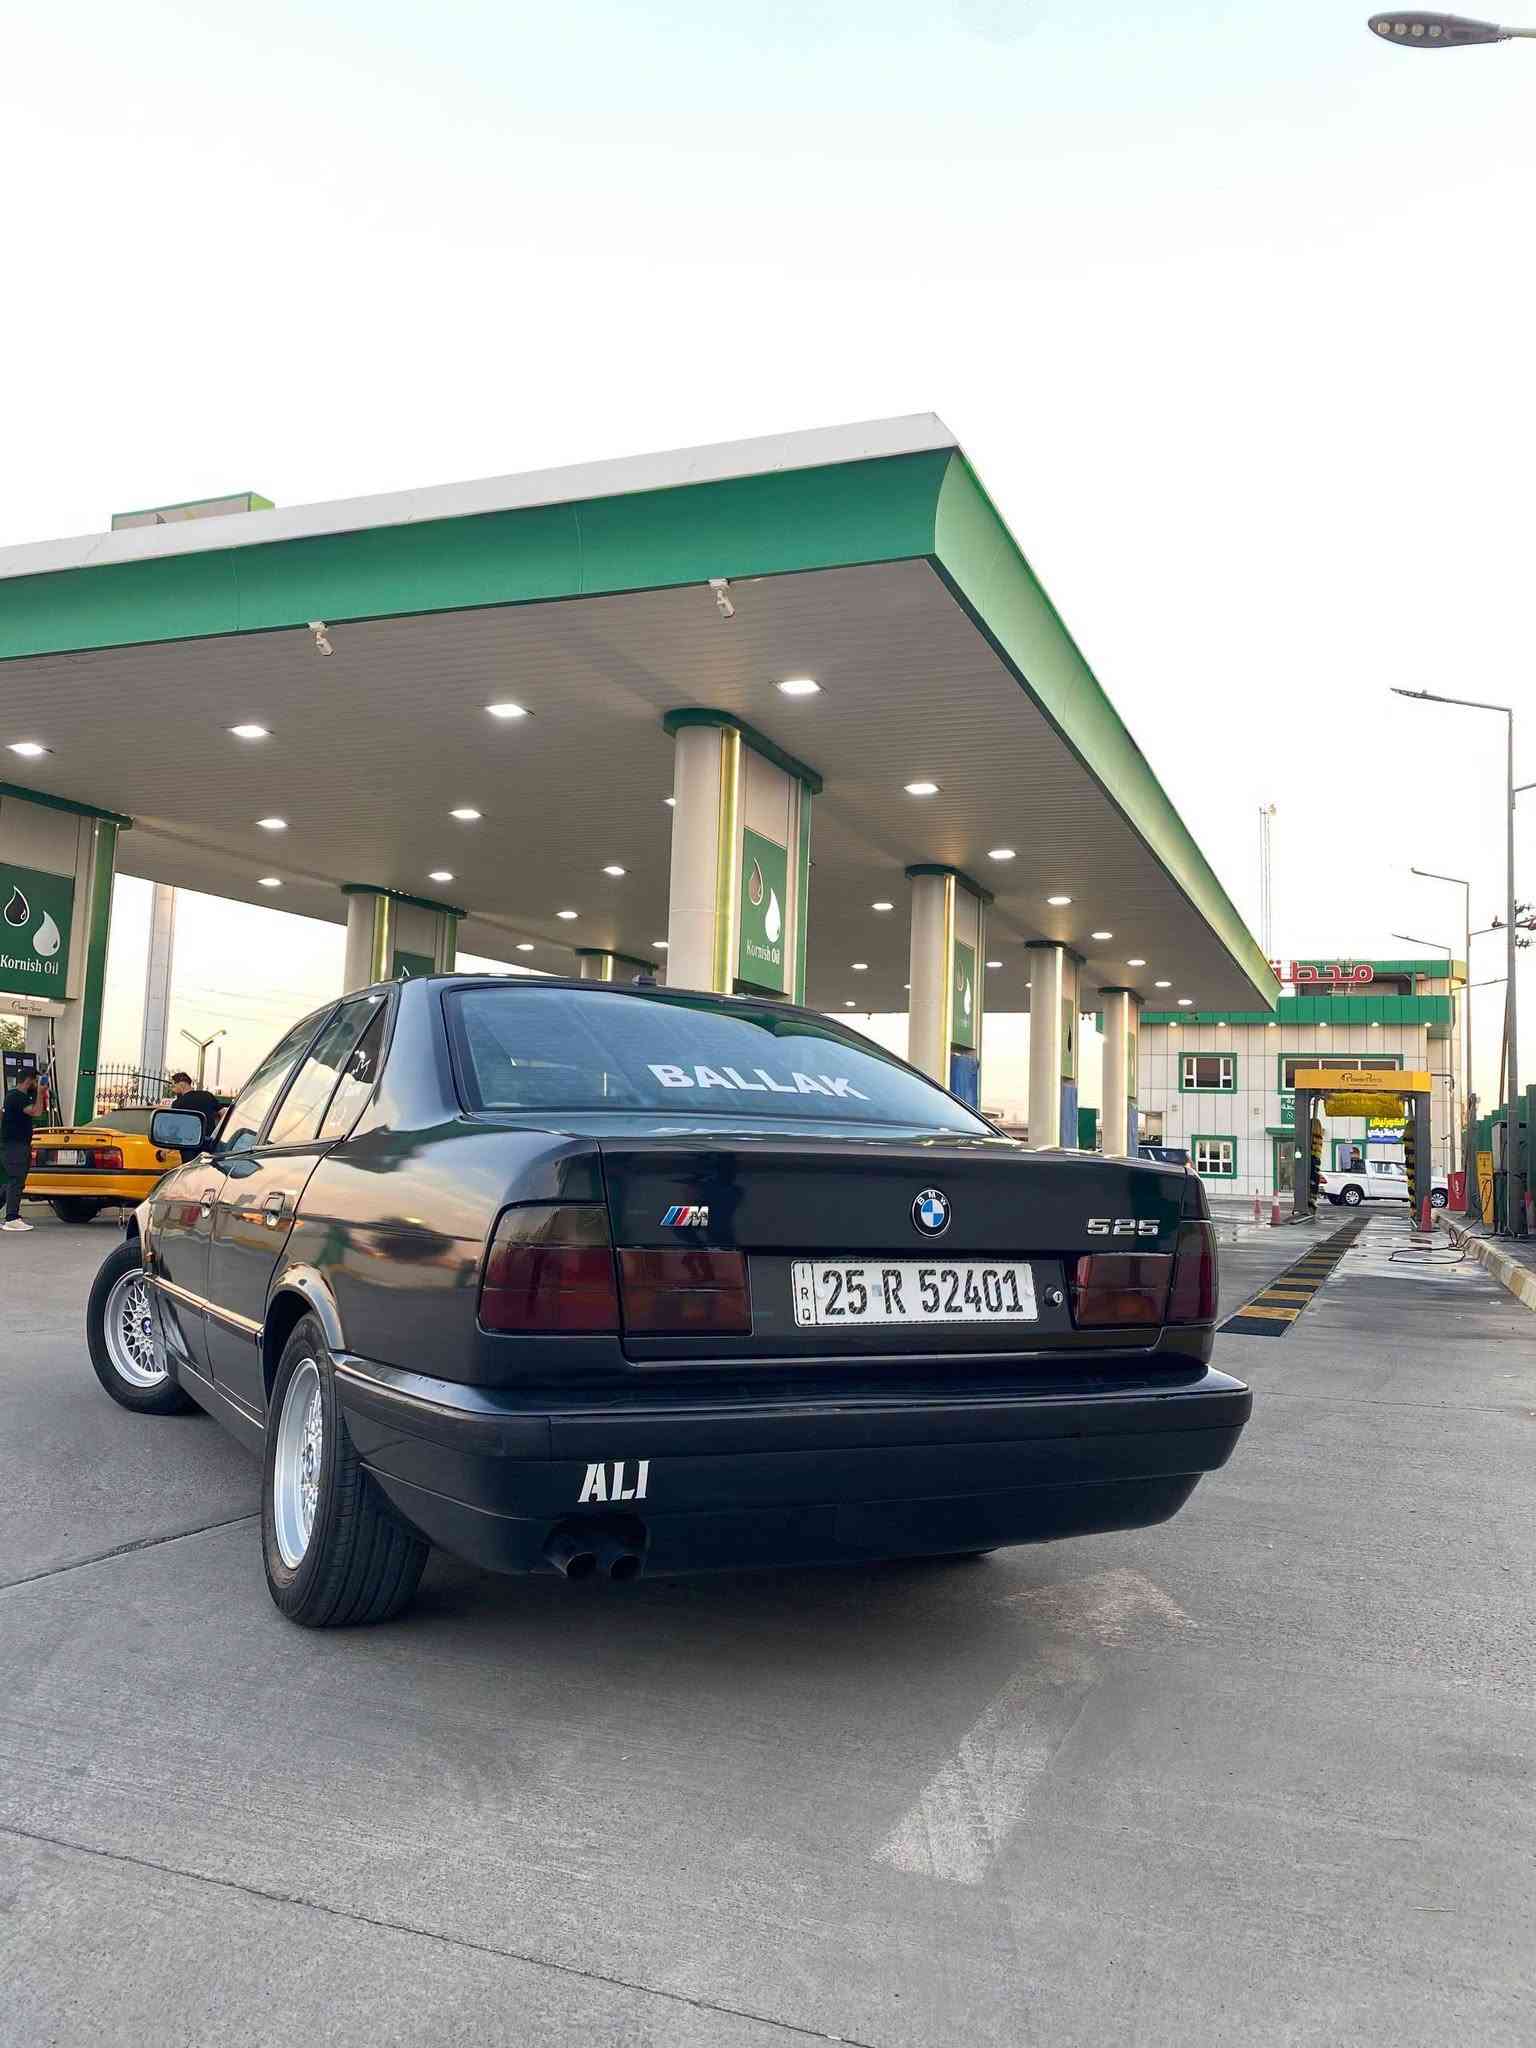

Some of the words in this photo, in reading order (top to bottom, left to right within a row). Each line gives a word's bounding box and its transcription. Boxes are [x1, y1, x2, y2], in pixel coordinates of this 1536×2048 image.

[0, 954, 42, 973] Kornish
[44, 961, 59, 975] Oil
[746, 938, 771, 962] Kornish
[648, 1064, 871, 1101] BALLAK
[1087, 1218, 1161, 1236] 525
[822, 1269, 867, 1315] 25
[882, 1269, 907, 1314] R
[918, 1269, 1024, 1313] 52401
[577, 1459, 650, 1503] ALI
